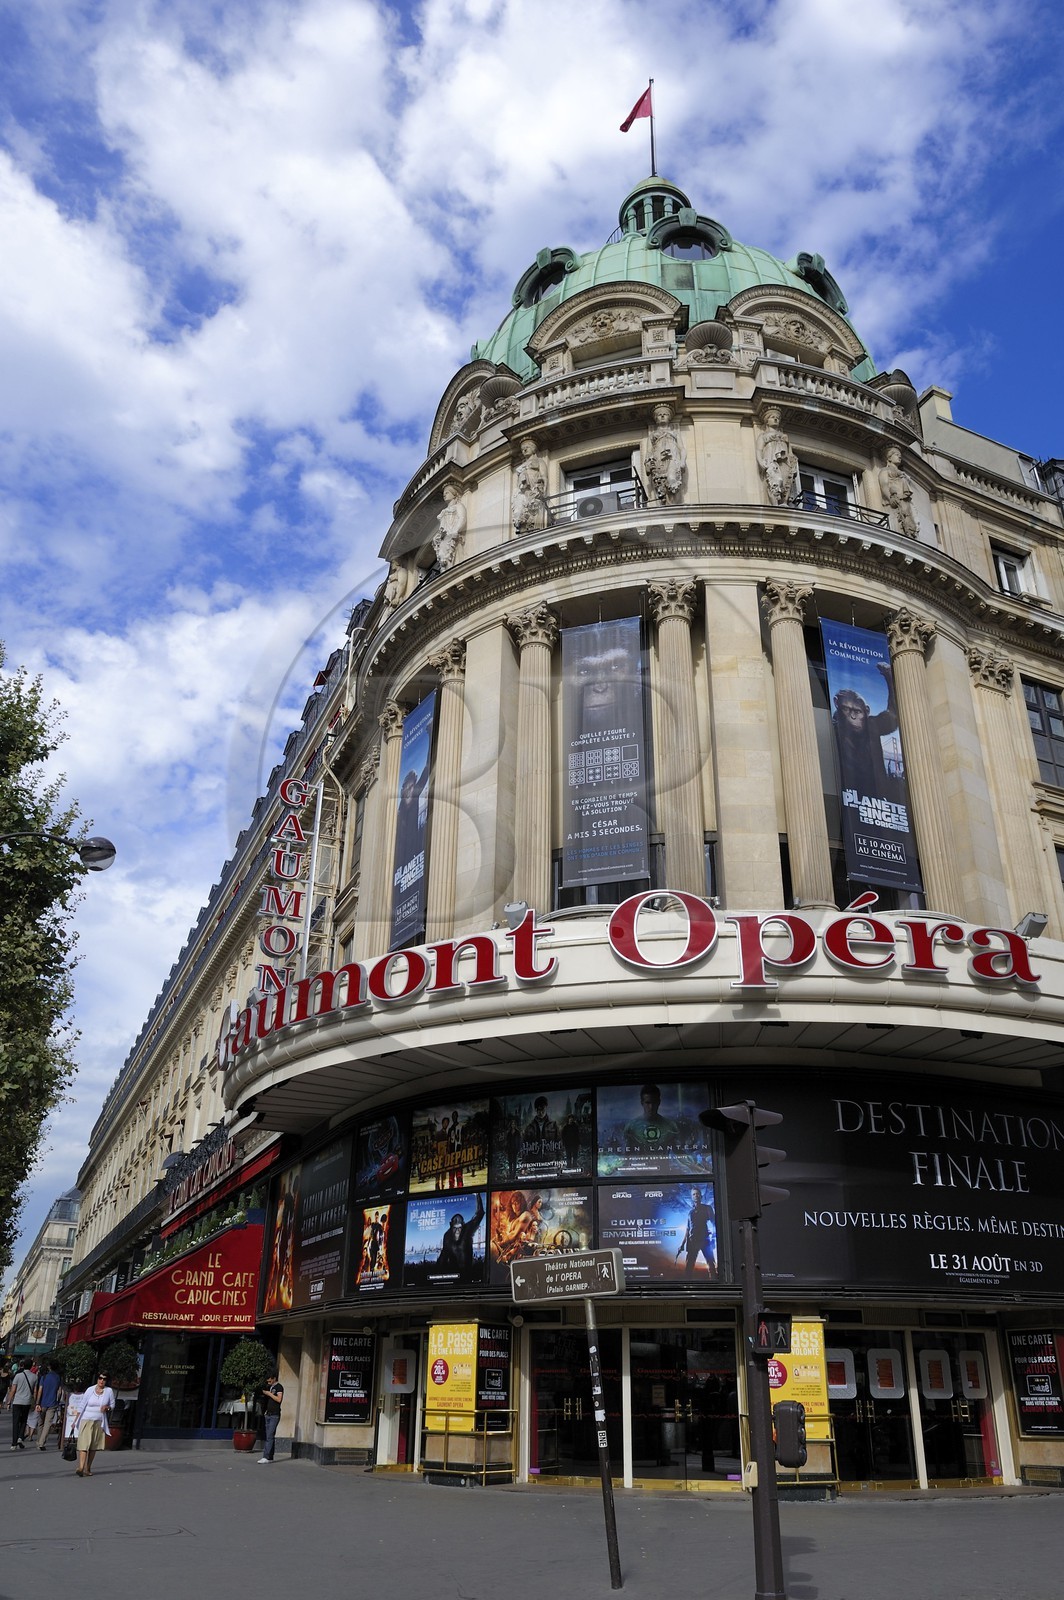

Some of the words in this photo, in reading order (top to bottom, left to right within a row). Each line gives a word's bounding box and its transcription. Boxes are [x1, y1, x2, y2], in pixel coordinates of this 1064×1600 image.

[829, 639, 838, 647] LA
[839, 641, 884, 659] RÉVOLUTION
[829, 648, 870, 665] COMMENCE
[570, 736, 602, 747] COMPLÈTE
[602, 735, 610, 743] LA
[610, 733, 628, 742] SUITE
[580, 731, 603, 741] QUELLE
[604, 728, 626, 738] FIGURE
[580, 796, 608, 805] COMBIEN
[617, 792, 638, 800] TEMPS
[842, 789, 906, 816] PLANÈTE
[574, 802, 610, 812] AVEZ-VOUS
[590, 806, 623, 816] SOLUTION
[858, 804, 908, 826] SINGES
[592, 819, 618, 830] CÉSAR
[860, 816, 874, 825] LES
[874, 818, 909, 833] ORIGINES
[574, 831, 590, 840] MIS
[592, 830, 598, 838] 3
[599, 824, 643, 837] SECONDES.
[858, 837, 868, 847] LE
[869, 839, 879, 849] 10
[880, 841, 902, 854] AOÛT
[858, 846, 870, 856] AU
[872, 848, 904, 862] CINÉMA
[606, 889, 1043, 988] Opéra
[520, 1141, 540, 1156] Harry
[542, 1138, 562, 1158] Potter
[650, 1144, 709, 1152] LANTERN
[420, 1155, 444, 1174] CASE
[908, 1151, 1031, 1193] FINALE
[410, 1208, 446, 1222] PLANÈTE
[610, 1218, 667, 1226] COWBOYS
[418, 1217, 446, 1228] SINGES
[803, 1211, 908, 1230] NOUVELLES
[912, 1210, 974, 1233] RÈGLES.
[977, 1215, 1019, 1236] MÊME
[602, 1230, 677, 1238] ENVAHISSEURS
[208, 1253, 222, 1269] LE
[544, 1262, 568, 1272] Théâtre
[570, 1258, 596, 1269] National
[929, 1253, 948, 1270] LE
[952, 1254, 968, 1270] 31
[972, 1253, 1011, 1273] AOÛT
[1014, 1260, 1028, 1272] EN
[1030, 1261, 1044, 1273] 3D
[171, 1270, 215, 1287] GRAND
[222, 1272, 255, 1288] CAFE
[546, 1275, 554, 1283] de
[174, 1289, 248, 1306] CAPUCINES
[142, 1312, 196, 1321] RESTAURANT
[200, 1314, 221, 1322] JOUR
[480, 1328, 492, 1339] UNE
[492, 1329, 509, 1340] CARTE
[1011, 1335, 1028, 1346] UNE
[1028, 1334, 1054, 1346] CARTE
[333, 1337, 348, 1346] UNE
[348, 1338, 372, 1347] CARTE
[1038, 1356, 1056, 1364] PLACES
[598, 1432, 608, 1447] BNE
